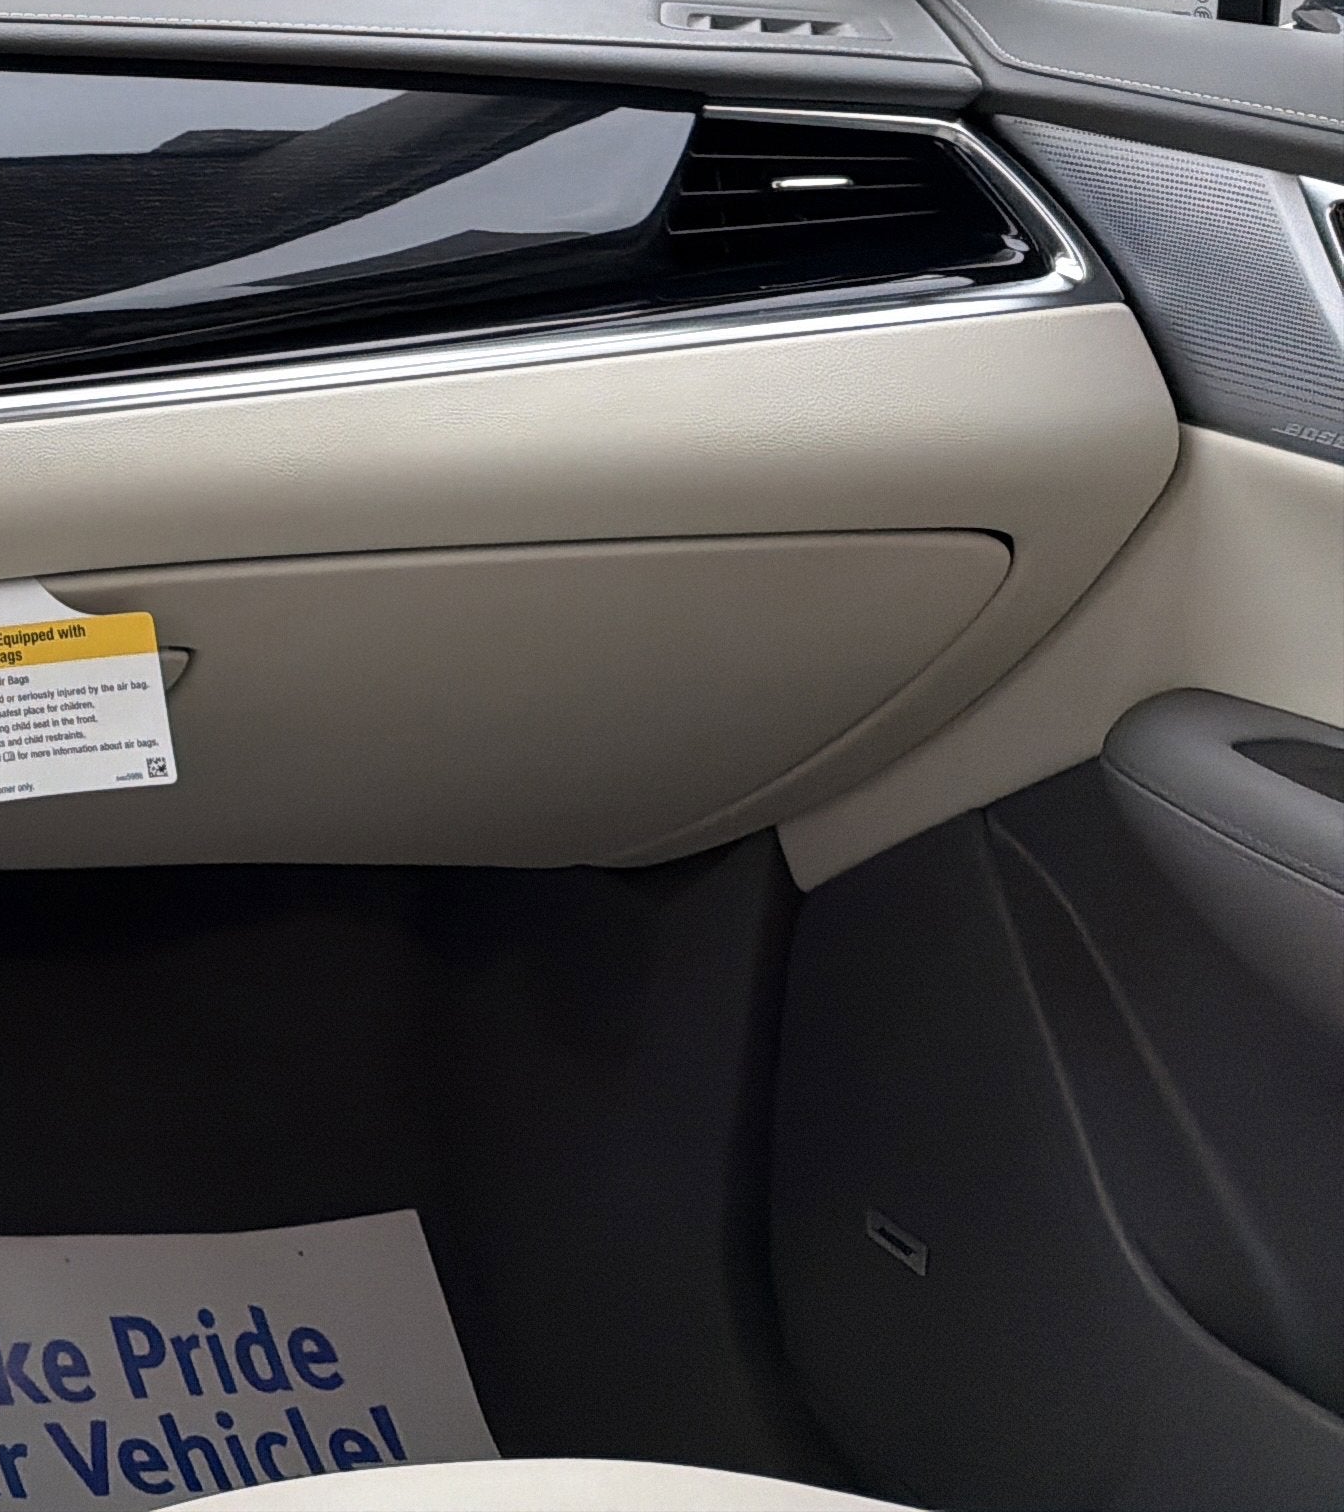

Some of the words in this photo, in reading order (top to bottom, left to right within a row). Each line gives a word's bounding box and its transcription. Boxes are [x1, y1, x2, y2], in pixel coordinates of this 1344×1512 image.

[57, 624, 86, 639] with
[8, 675, 29, 686] Bags
[18, 690, 54, 702] seriously
[57, 686, 86, 698] injured
[88, 685, 98, 695] by
[101, 683, 114, 692] the
[117, 681, 128, 691] air
[23, 706, 44, 717] place
[47, 704, 57, 712] for
[12, 721, 31, 731] child
[33, 719, 49, 728] seat
[52, 718, 59, 727] in
[62, 716, 74, 725] the
[8, 737, 22, 746] and
[24, 735, 43, 744] child
[17, 751, 28, 759] for
[31, 750, 50, 758] more
[53, 744, 97, 755] information
[100, 741, 122, 751] about
[125, 740, 134, 748] air
[110, 1304, 346, 1398] Pride
